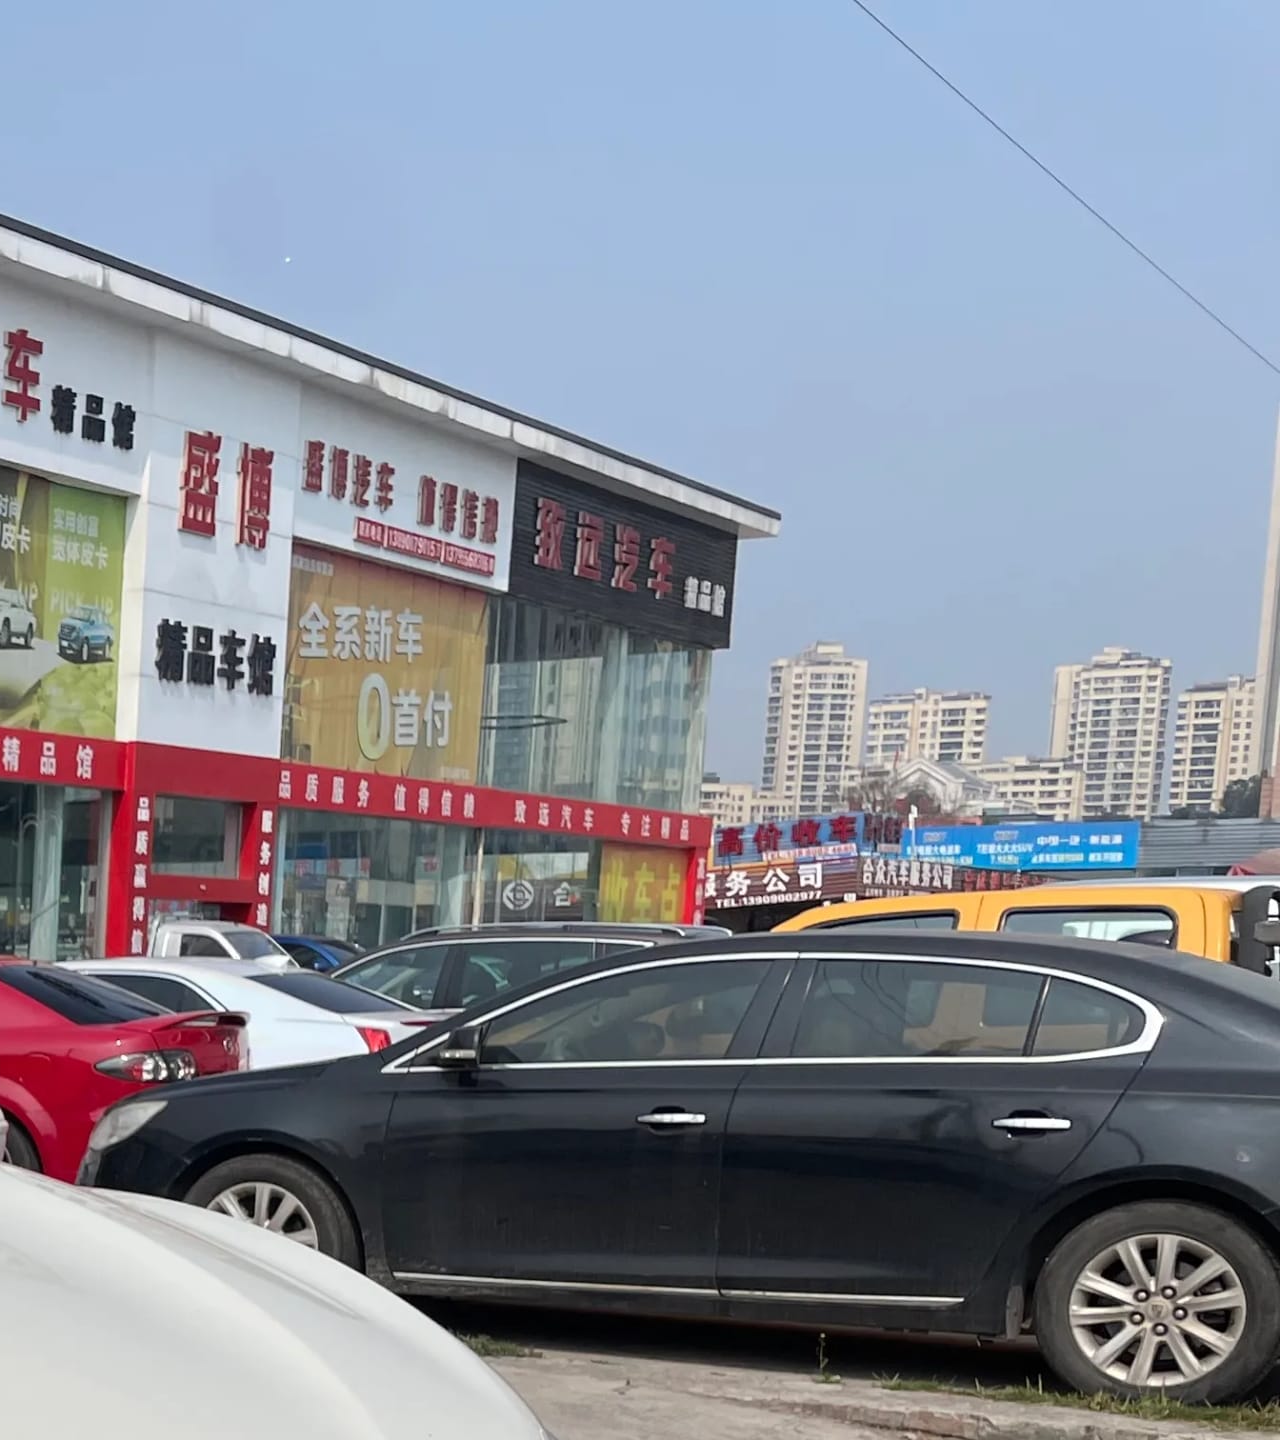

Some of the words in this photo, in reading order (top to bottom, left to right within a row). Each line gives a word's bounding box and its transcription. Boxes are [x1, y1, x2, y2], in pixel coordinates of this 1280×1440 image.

[50, 384, 137, 451] 精品馆
[178, 431, 275, 550] 盛博
[301, 440, 396, 514] 盛博汽车
[417, 474, 500, 544] 值得信赖
[534, 497, 677, 600] 致远汽车
[155, 618, 277, 697] 精品车馆
[298, 601, 423, 664] 全系新车
[357, 672, 453, 760] 0首付
[278, 770, 370, 808] 品质服务
[394, 783, 475, 819] 值得信赖
[514, 799, 595, 832] 致远汽车
